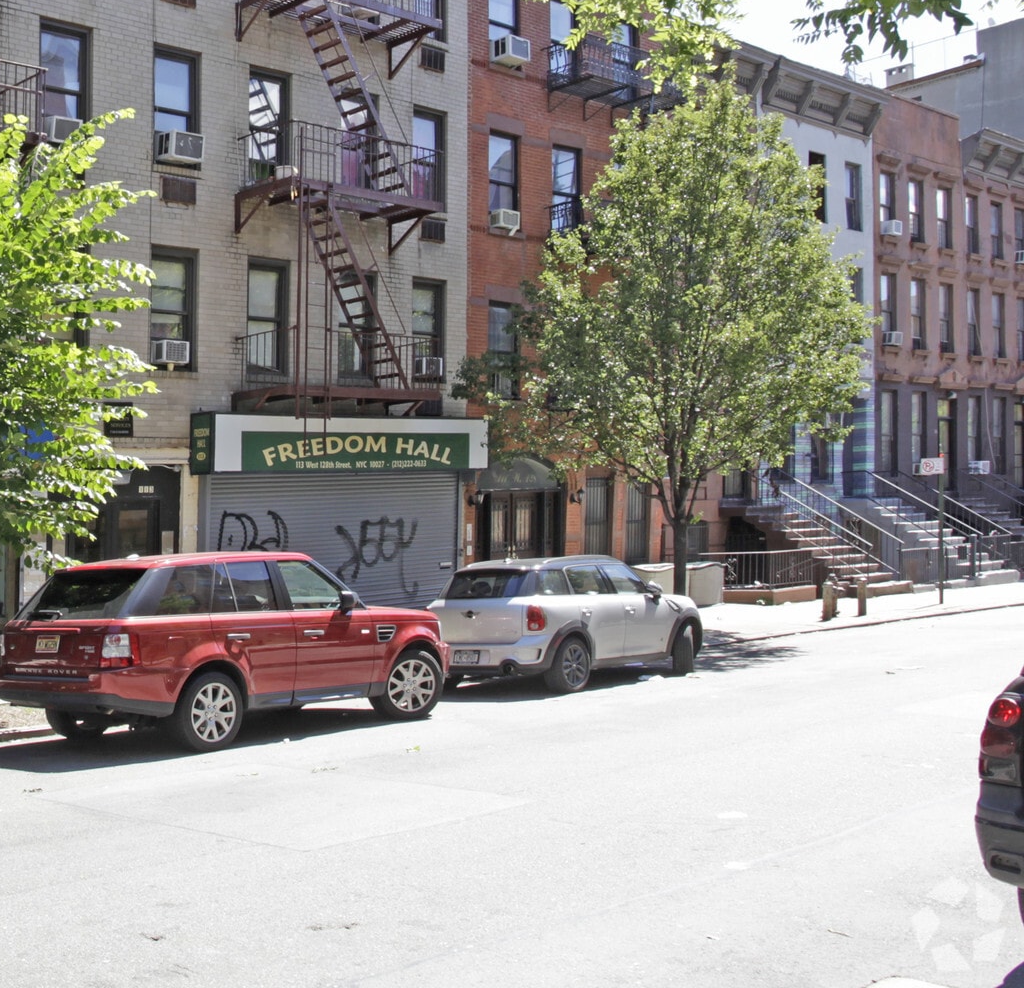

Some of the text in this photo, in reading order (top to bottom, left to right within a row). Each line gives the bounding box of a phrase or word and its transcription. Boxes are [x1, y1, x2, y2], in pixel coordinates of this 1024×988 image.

[262, 435, 451, 466] FREEDOM HALL
[306, 461, 319, 469] West
